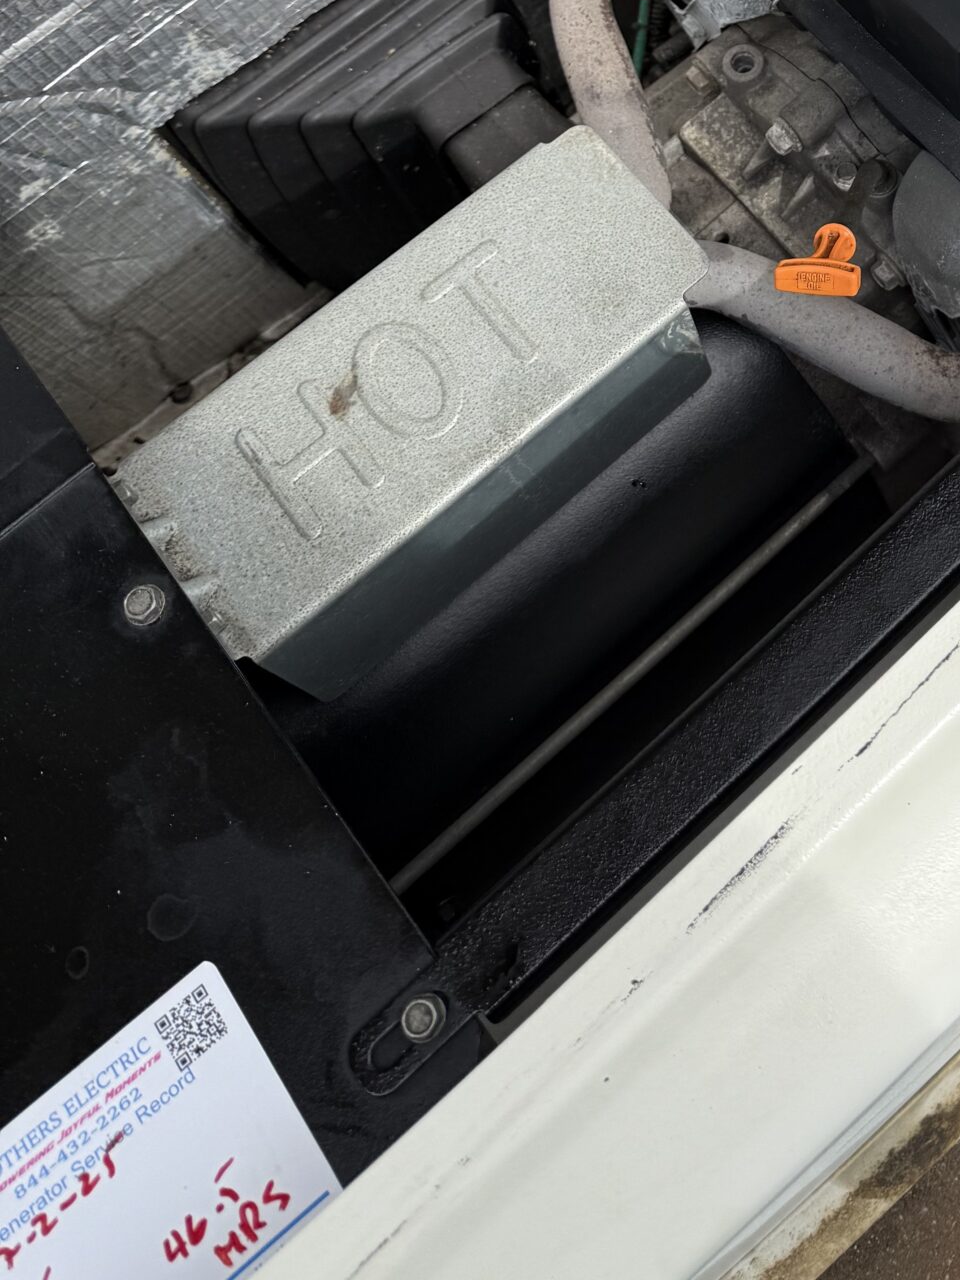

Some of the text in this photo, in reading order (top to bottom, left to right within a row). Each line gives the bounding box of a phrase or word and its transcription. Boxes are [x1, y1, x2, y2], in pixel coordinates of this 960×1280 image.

[235, 238, 542, 541] HOT
[63, 1036, 151, 1119] ELECTRIC
[71, 1122, 134, 1177] Service
[134, 1067, 196, 1125] Record
[15, 1087, 143, 1201] 844-432-2262
